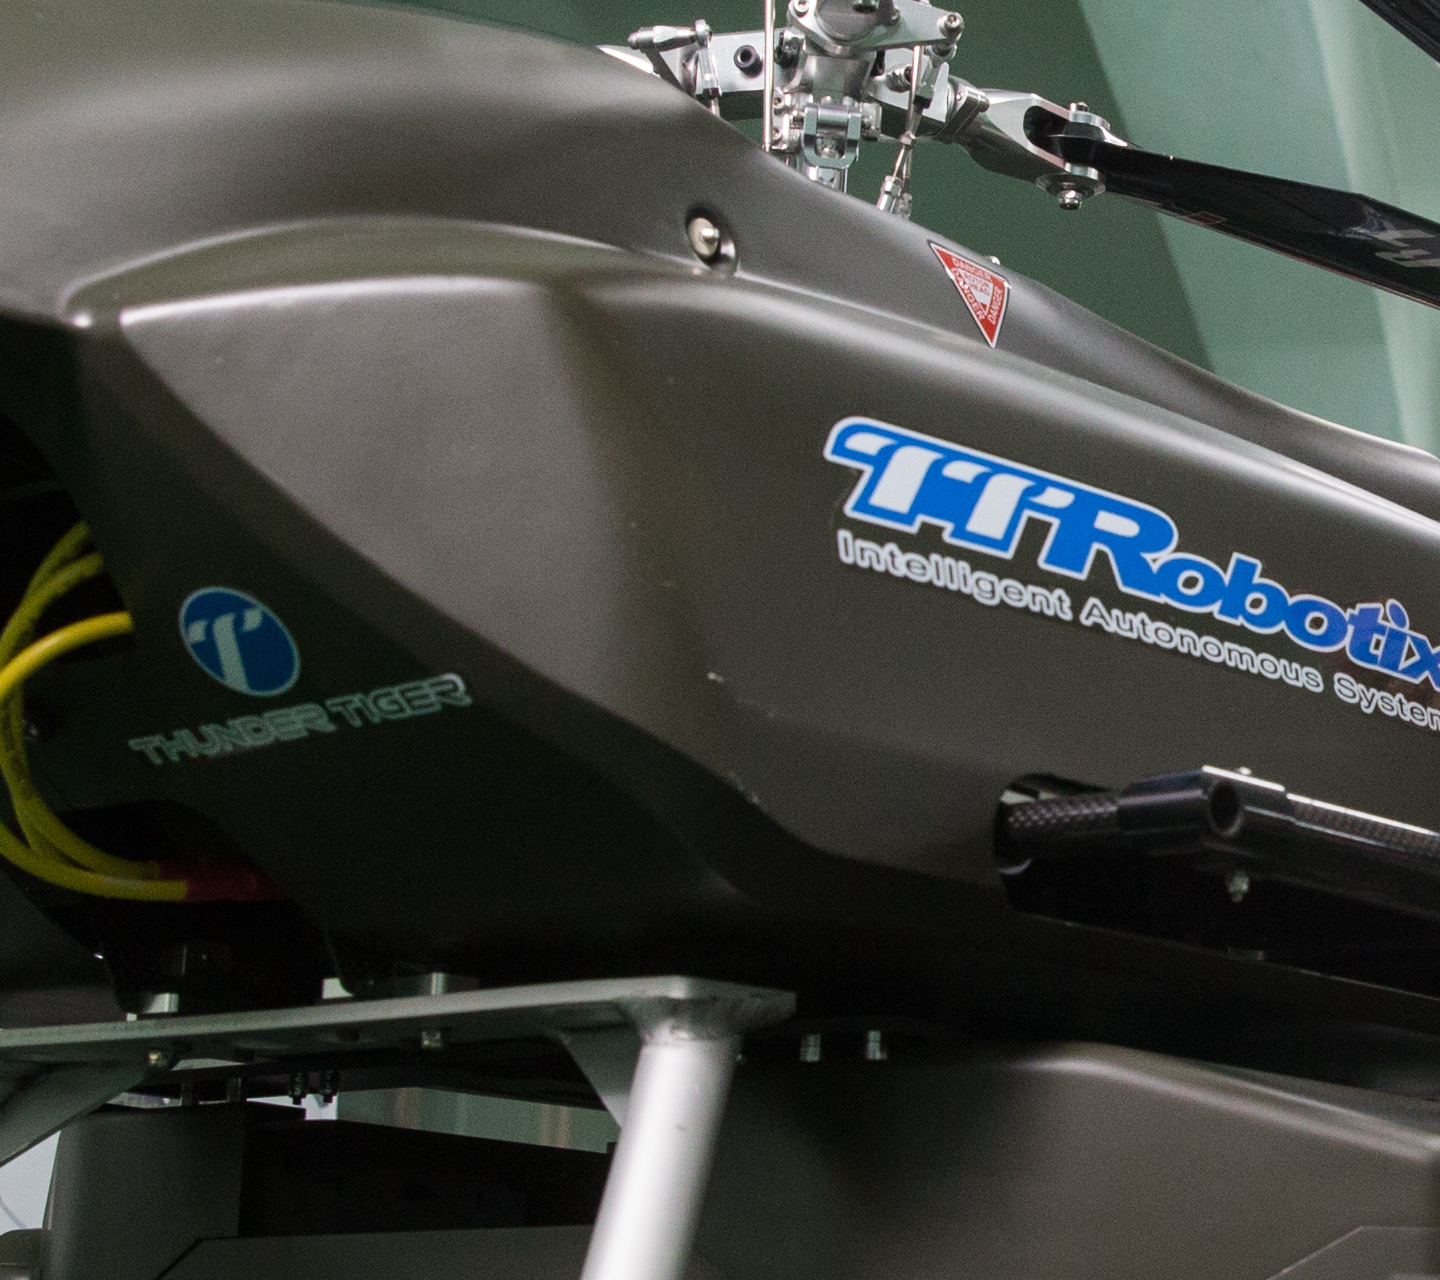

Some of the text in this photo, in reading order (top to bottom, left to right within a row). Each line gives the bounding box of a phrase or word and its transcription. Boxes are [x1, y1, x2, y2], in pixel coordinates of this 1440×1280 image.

[951, 256, 993, 283] DANGER
[951, 267, 986, 320] DANGER
[987, 285, 1003, 325] DANGER
[836, 528, 1073, 623] Intelligent
[1080, 596, 1324, 694] Autonomous
[128, 672, 473, 766] THUNDER TIGER
